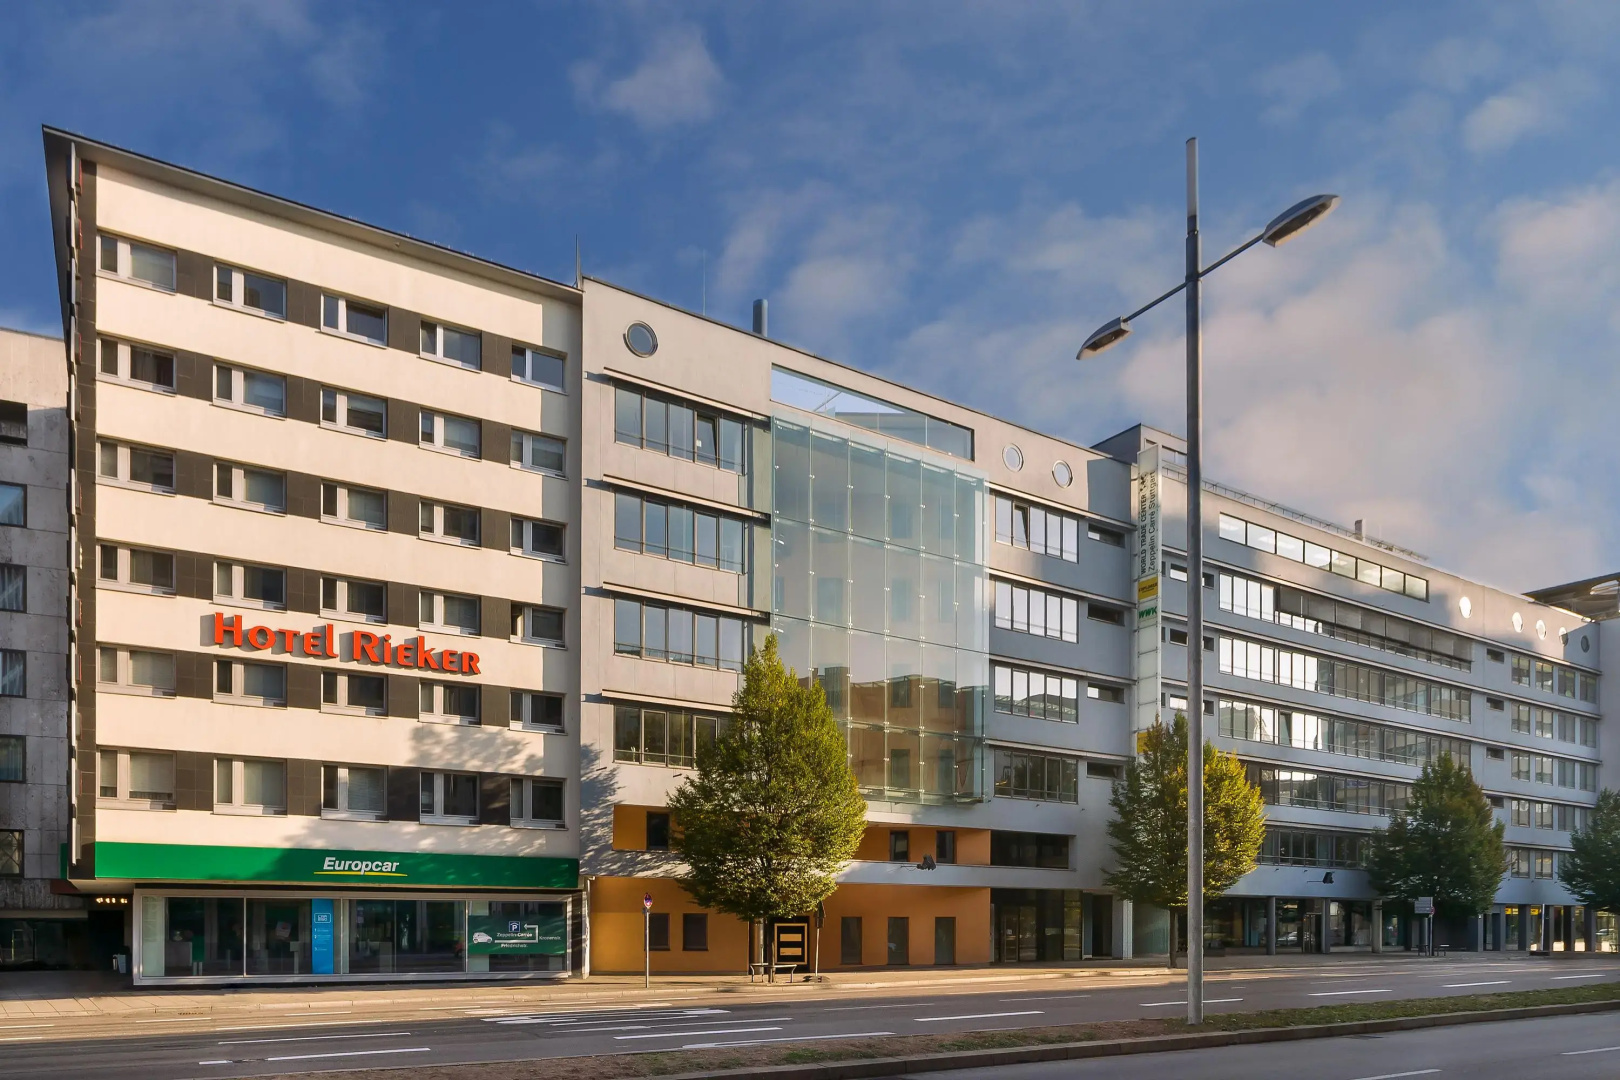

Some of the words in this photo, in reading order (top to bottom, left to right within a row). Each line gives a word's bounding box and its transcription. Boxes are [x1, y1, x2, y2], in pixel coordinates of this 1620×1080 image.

[1148, 471, 1156, 509] Stuttgart
[1148, 510, 1156, 534] Carré
[1148, 535, 1156, 572] Zeppelin
[1138, 606, 1158, 620] WWK
[323, 856, 400, 875] Europcar
